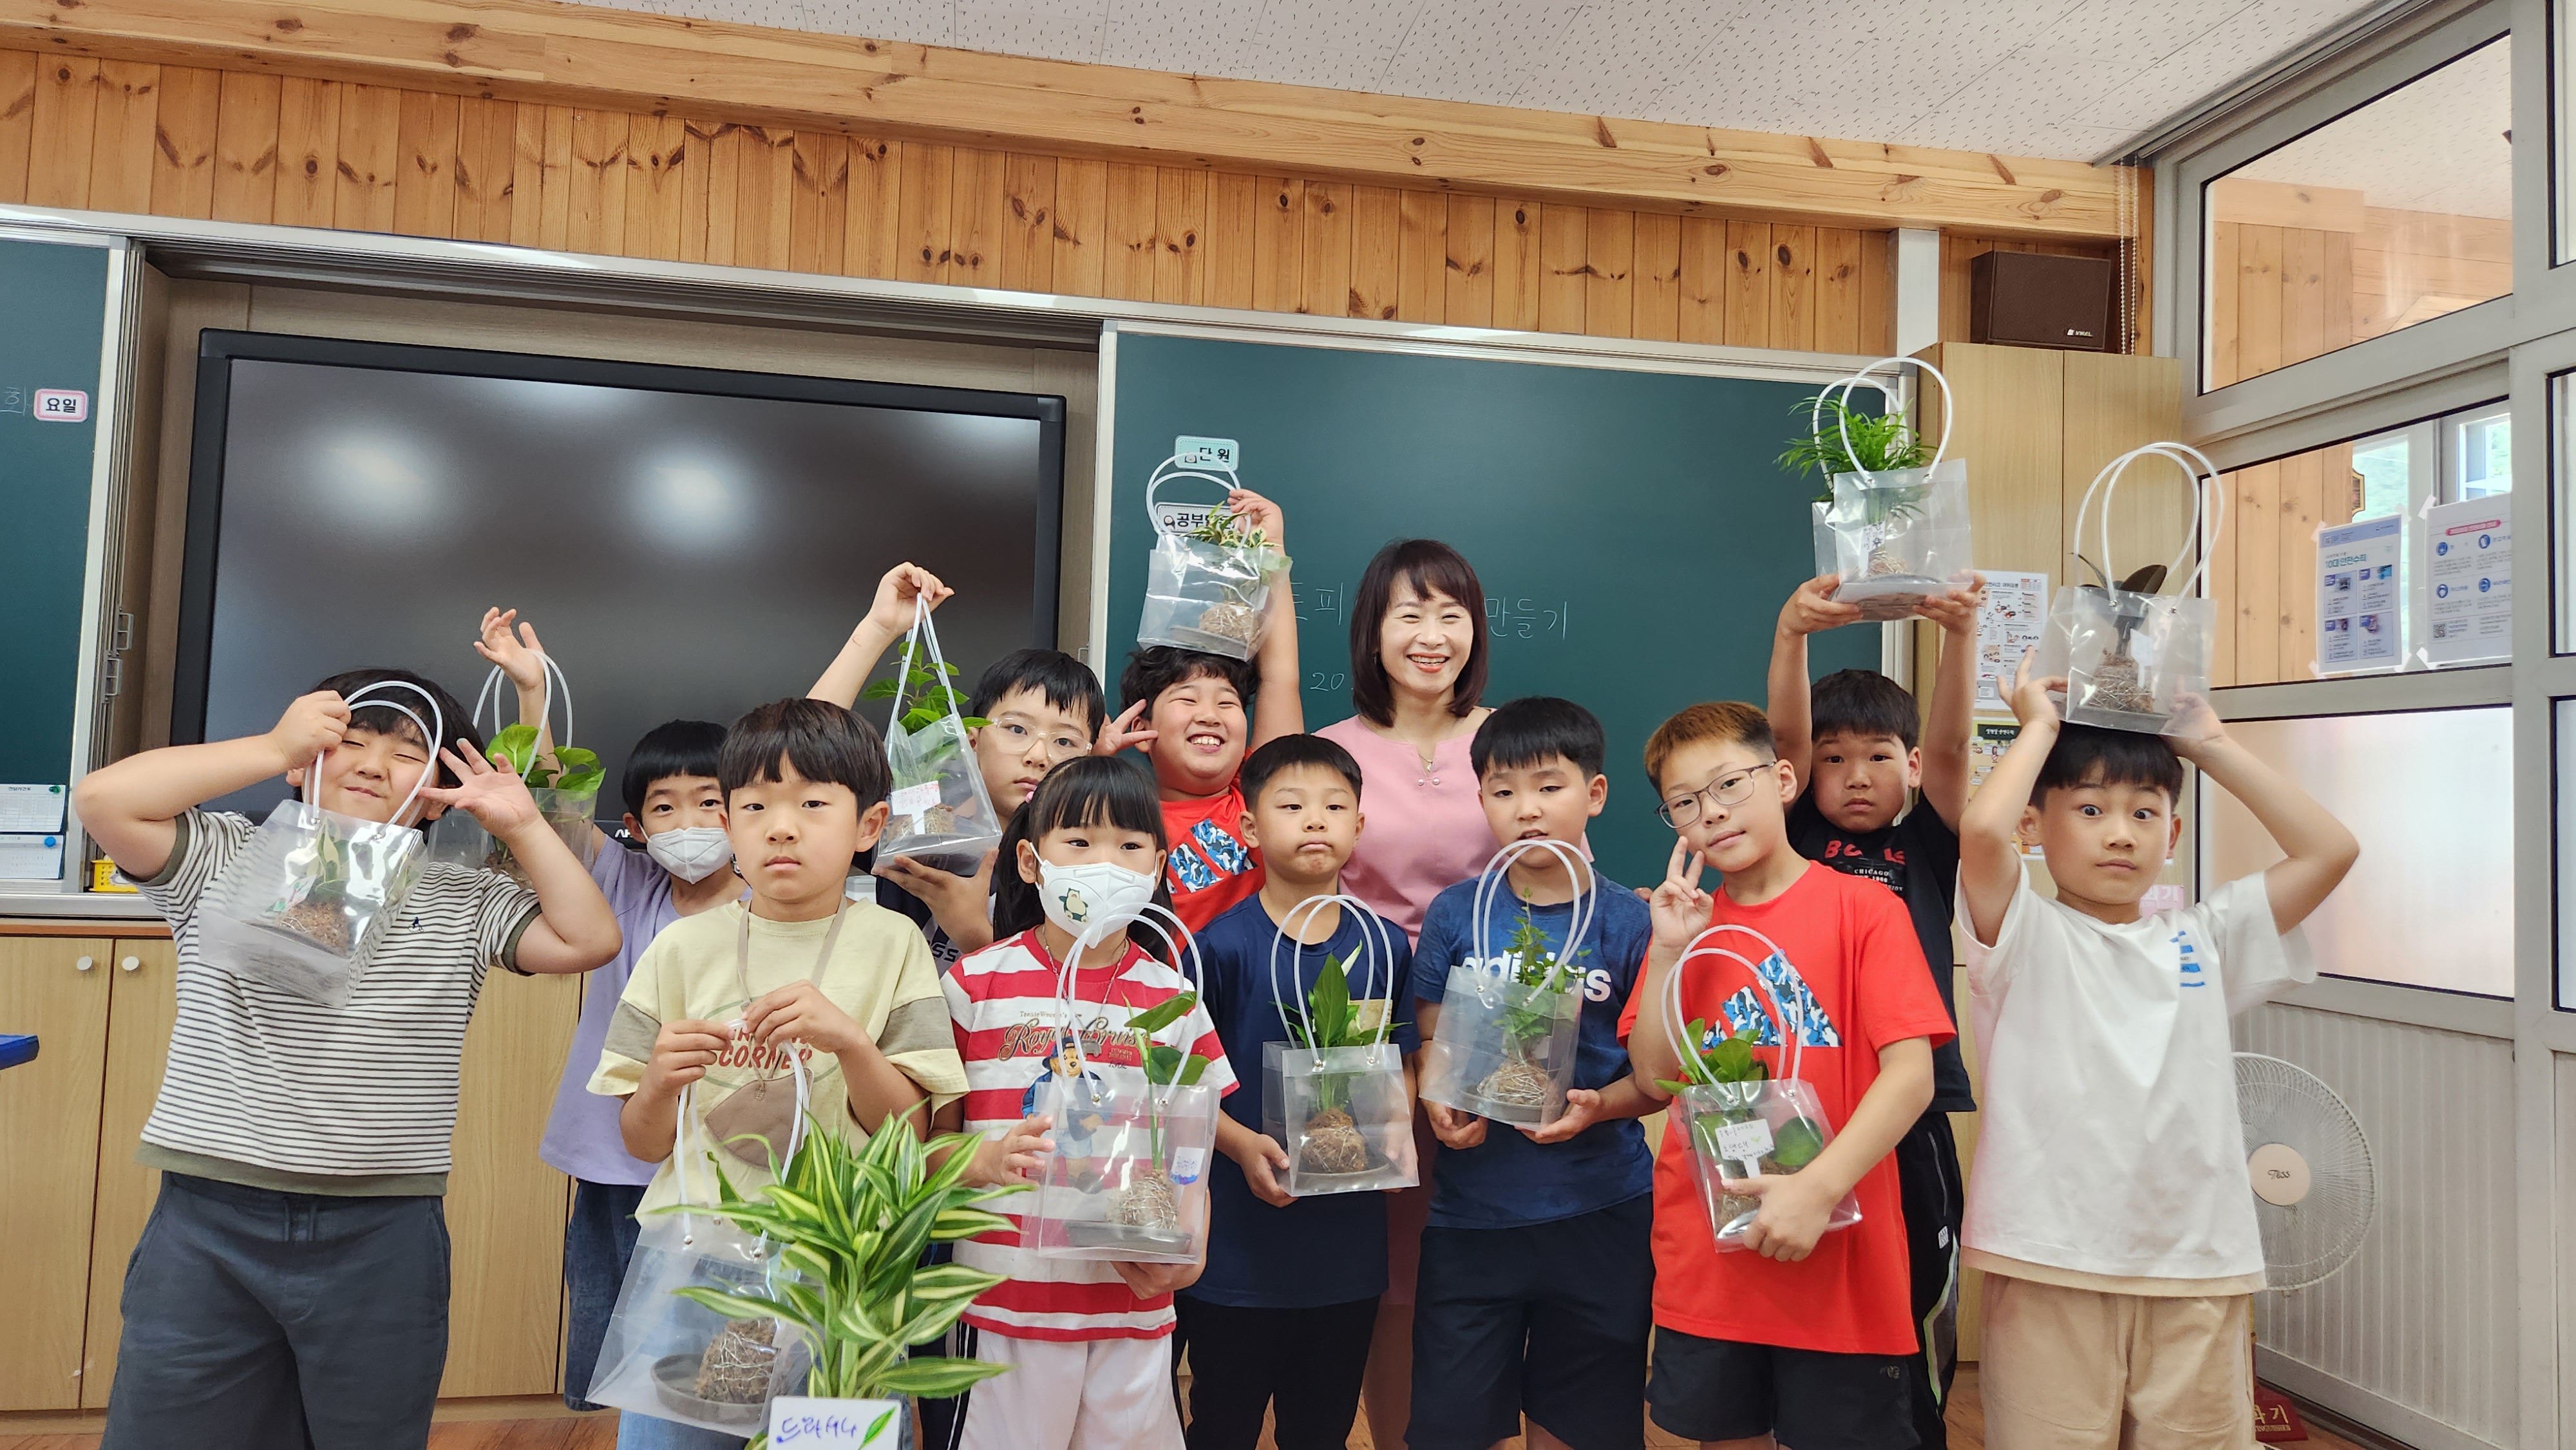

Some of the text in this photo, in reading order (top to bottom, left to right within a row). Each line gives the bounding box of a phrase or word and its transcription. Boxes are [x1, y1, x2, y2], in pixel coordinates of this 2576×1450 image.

[46, 398, 77, 413] 요일
[1484, 597, 1568, 640] 만들기
[1853, 868, 1889, 876] CHICAGO
[1462, 949, 1612, 1003] adids
